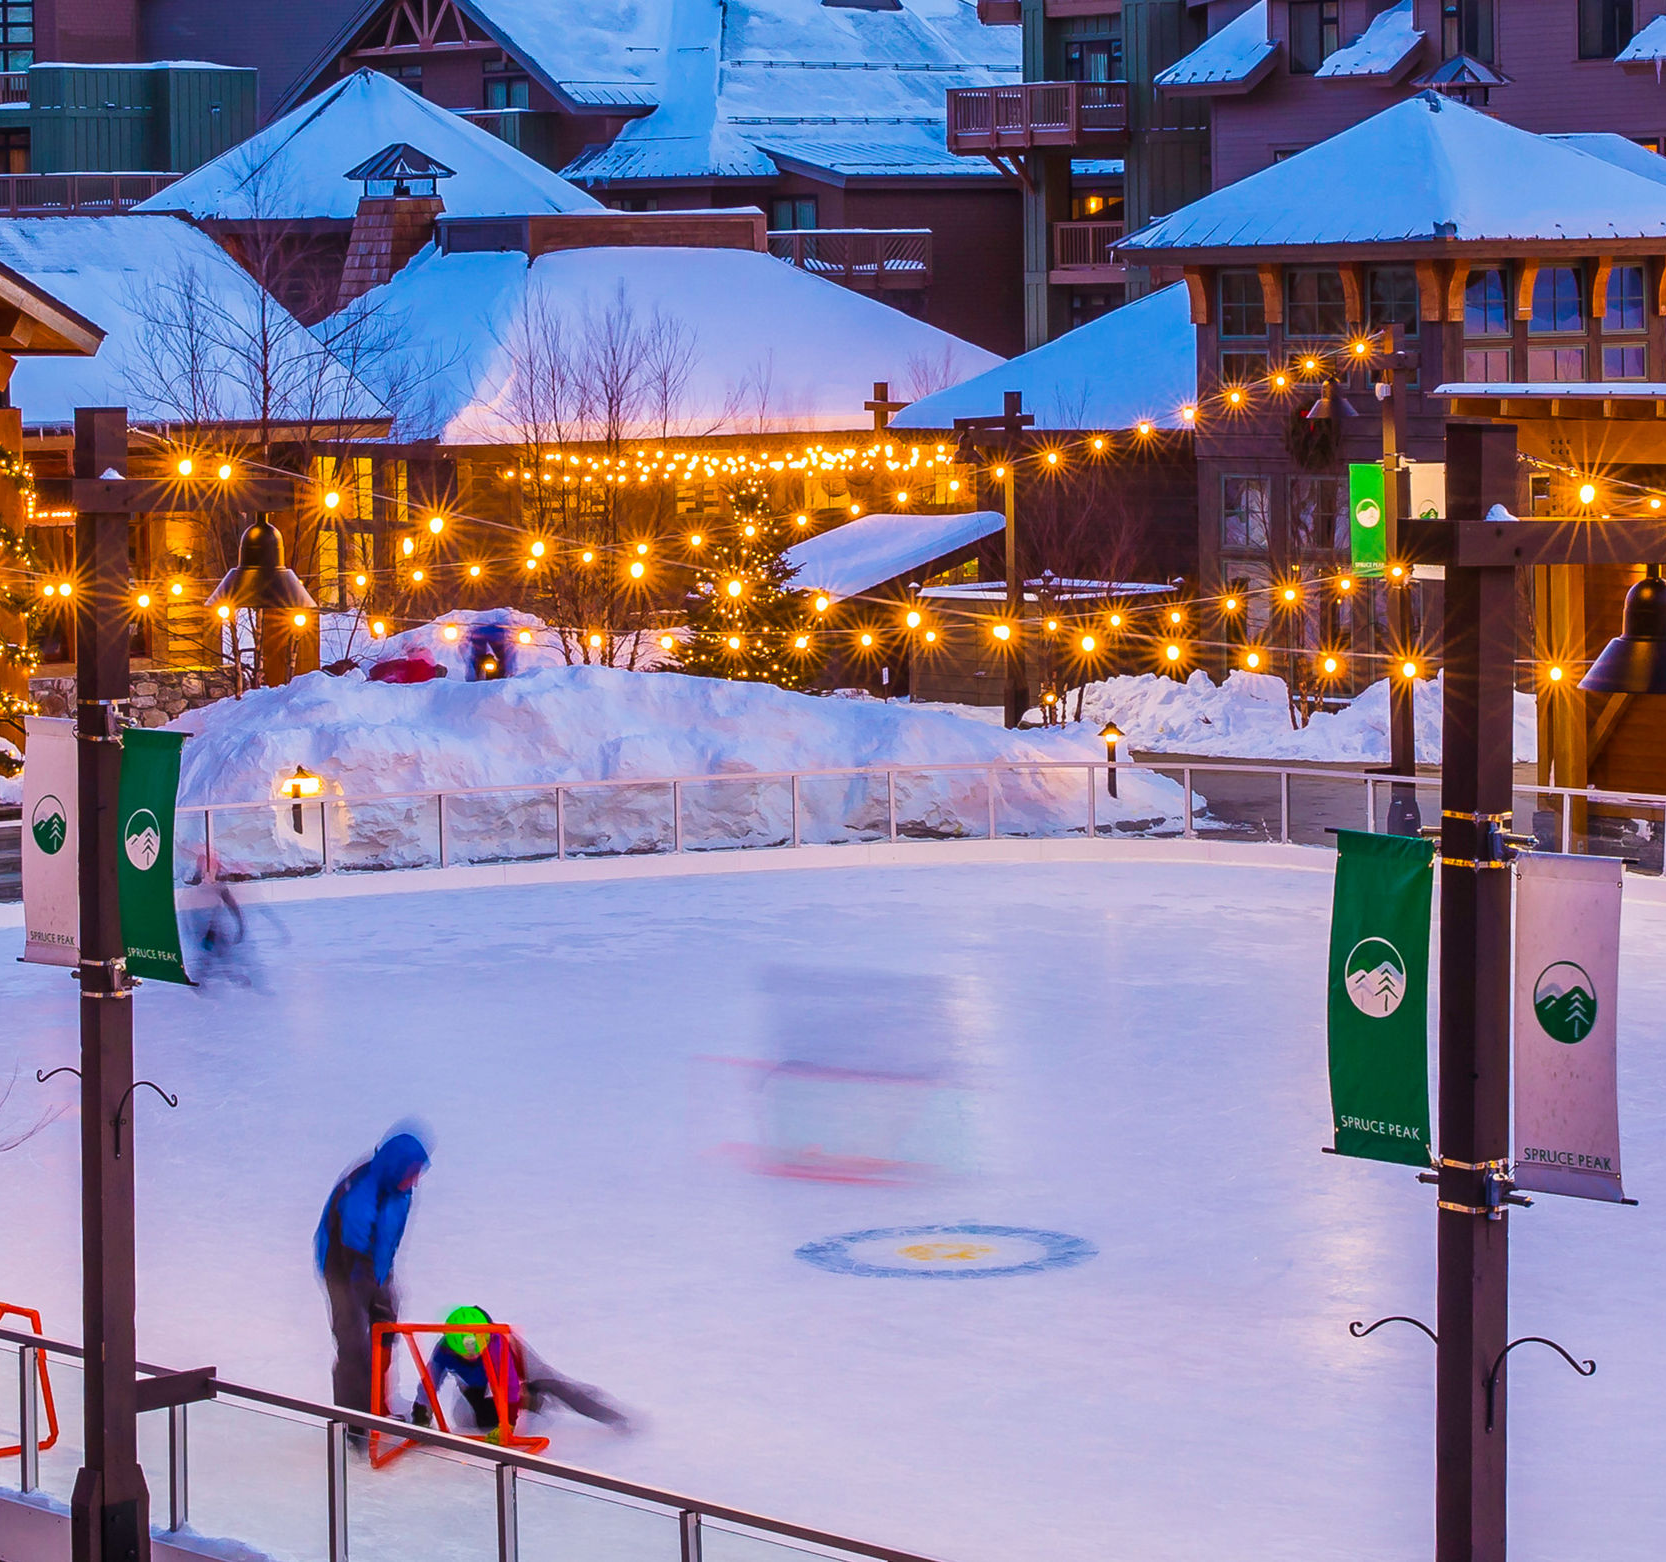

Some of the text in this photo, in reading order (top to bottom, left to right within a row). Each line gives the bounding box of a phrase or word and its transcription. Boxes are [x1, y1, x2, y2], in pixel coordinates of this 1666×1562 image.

[30, 930, 75, 946] SPRUCE PEAK
[127, 946, 178, 963] SPRUCE PEAK
[1340, 1114, 1420, 1141] SPRUCE PEAK
[1524, 1147, 1612, 1171] SPRUCE PEAK
